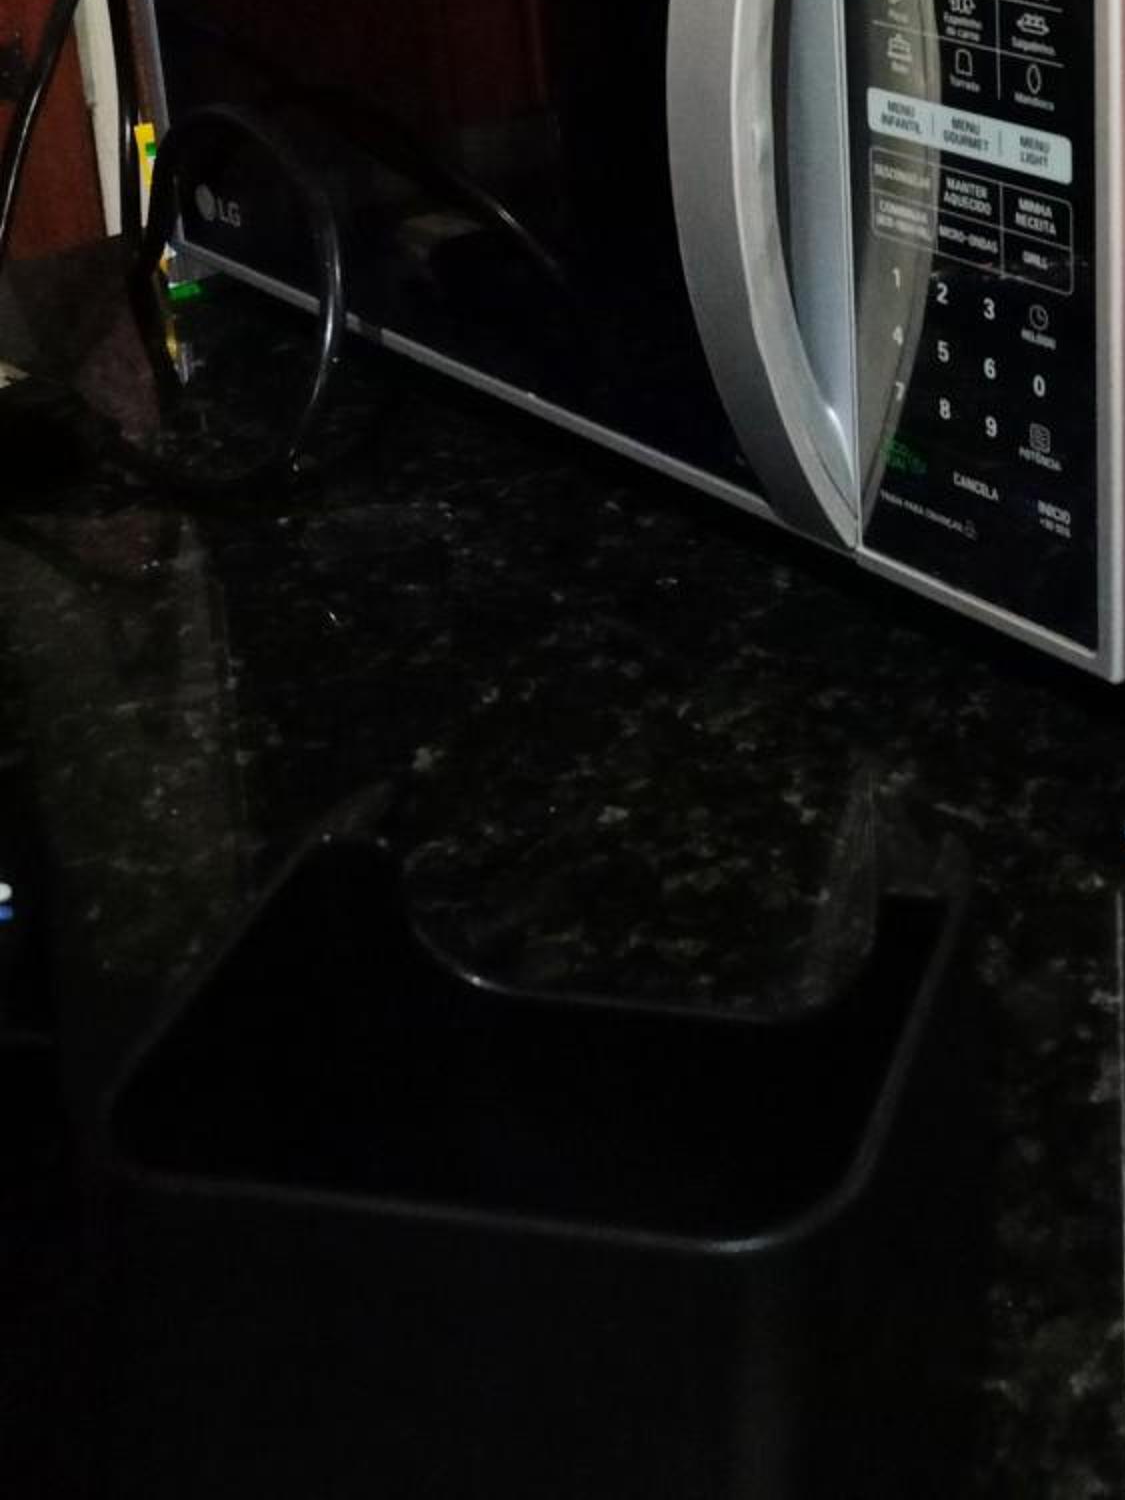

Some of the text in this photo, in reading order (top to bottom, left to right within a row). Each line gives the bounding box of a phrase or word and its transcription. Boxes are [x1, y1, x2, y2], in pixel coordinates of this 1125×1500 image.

[887, 99, 916, 119] MENU
[951, 116, 980, 137] MENU
[943, 128, 989, 152] GOURMET
[1019, 135, 1049, 155] MENU
[1019, 150, 1048, 169] LIGHT
[945, 176, 988, 200] MANTER
[216, 196, 242, 228] LG
[943, 190, 992, 217] AQUECIDO
[1015, 210, 1057, 237] RECEITA
[892, 266, 902, 290] 1
[936, 281, 949, 306] 2
[983, 296, 996, 321] 3
[892, 325, 904, 348] 4
[937, 339, 950, 364] 5
[983, 357, 996, 381] 6
[895, 380, 906, 402] 7
[1033, 374, 1046, 399] 0
[939, 396, 951, 421] 8
[985, 415, 998, 439] 9
[953, 468, 999, 502] CANCELA
